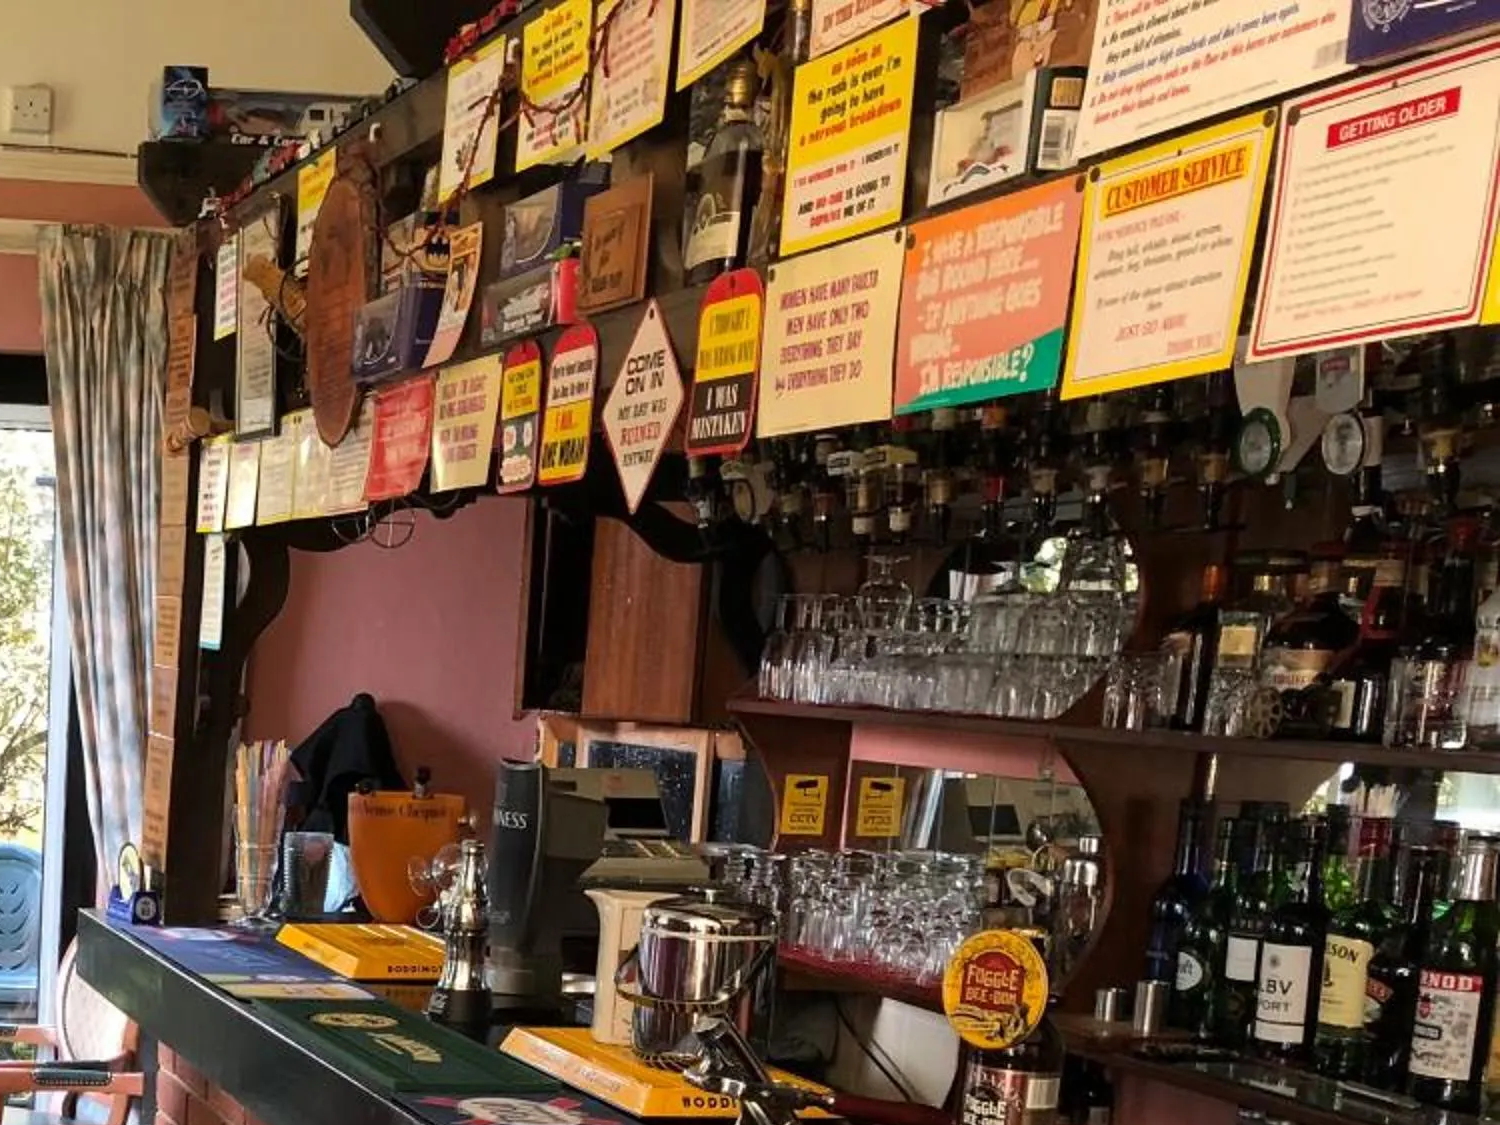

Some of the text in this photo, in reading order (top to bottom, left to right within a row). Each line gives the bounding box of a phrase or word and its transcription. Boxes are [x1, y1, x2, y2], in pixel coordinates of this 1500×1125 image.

[1338, 96, 1447, 142] GETTING OLDER
[1106, 145, 1247, 211] CUSTOMER SERVICE
[626, 350, 666, 376] COME
[625, 371, 665, 396] ON IN
[715, 383, 739, 409] WAS
[617, 399, 668, 421] MY DAY WAS
[620, 422, 661, 446] RUINED
[690, 411, 746, 440] MISTAKEN
[621, 449, 655, 467] ANYWAY
[499, 810, 528, 829] NESS
[789, 815, 819, 824] CCTV
[1329, 943, 1360, 963] SON
[387, 965, 443, 974] BODDINGT
[1261, 1000, 1291, 1012] ORT
[682, 1096, 738, 1109] BODDI
